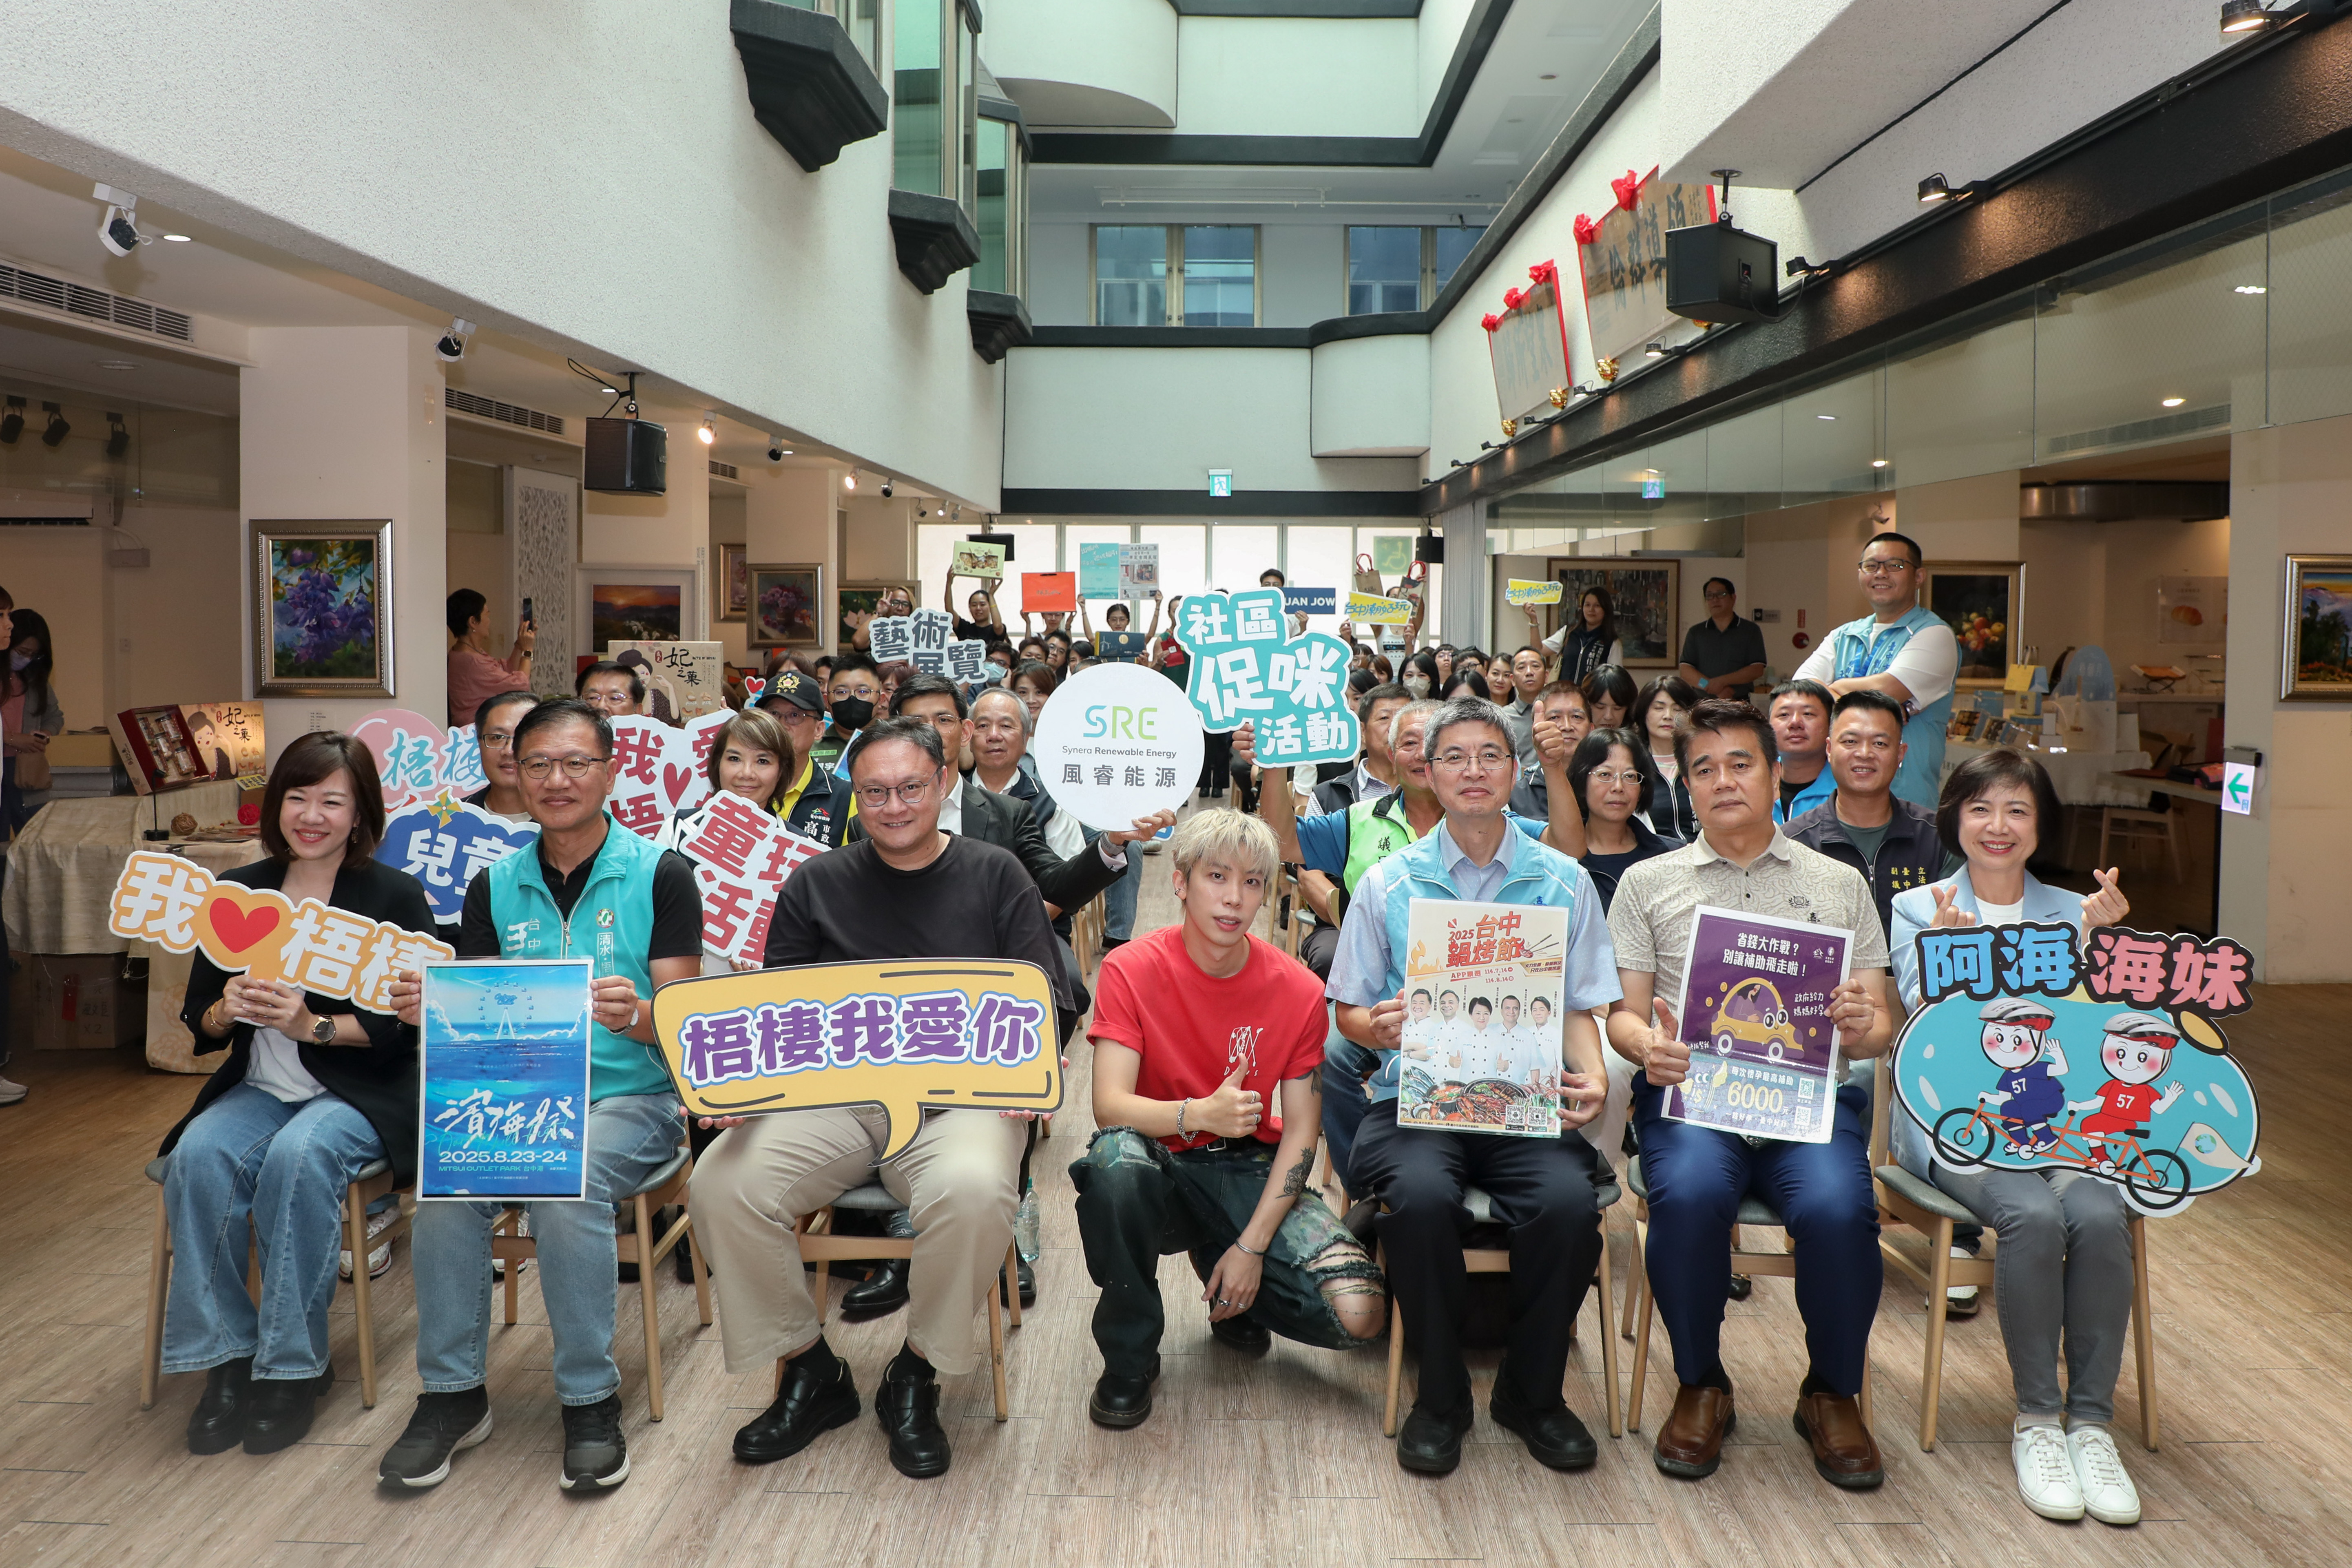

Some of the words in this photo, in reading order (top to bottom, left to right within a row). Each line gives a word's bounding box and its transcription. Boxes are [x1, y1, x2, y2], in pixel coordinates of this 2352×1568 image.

[1310, 597, 1335, 606] JOW
[873, 613, 949, 656] 藝術
[1186, 598, 1277, 645] 社區
[1197, 641, 1341, 721] 促咪
[1083, 705, 1157, 740] SRE
[1261, 711, 1349, 756] 活動
[1062, 745, 1092, 756] Synera
[1095, 747, 1144, 756] Renewable
[1146, 749, 1177, 759] Energy
[1062, 764, 1176, 787] 風睿能源
[821, 824, 831, 846] 市政
[1918, 867, 1926, 886] 立法
[120, 860, 206, 944] 我
[528, 918, 541, 951] 台中
[1448, 929, 1474, 941] 2025
[1476, 911, 1522, 939] 台中
[1446, 936, 1524, 968] 鍋烤節
[1921, 927, 2076, 997] 阿海
[2091, 934, 2247, 1011] 海妹
[1793, 1004, 1824, 1017] 媽媽好孕
[1794, 992, 1824, 1003] 政府給力
[685, 995, 1040, 1081] 梧棲我愛你
[1731, 1066, 1794, 1086] 每次懷孕最高補助
[2011, 1077, 2027, 1094] 57
[1728, 1081, 1789, 1115] 6000元
[2115, 1094, 2135, 1110] 57
[434, 1088, 576, 1149] 濱海祭
[439, 1151, 568, 1163] 2025.8.23-24
